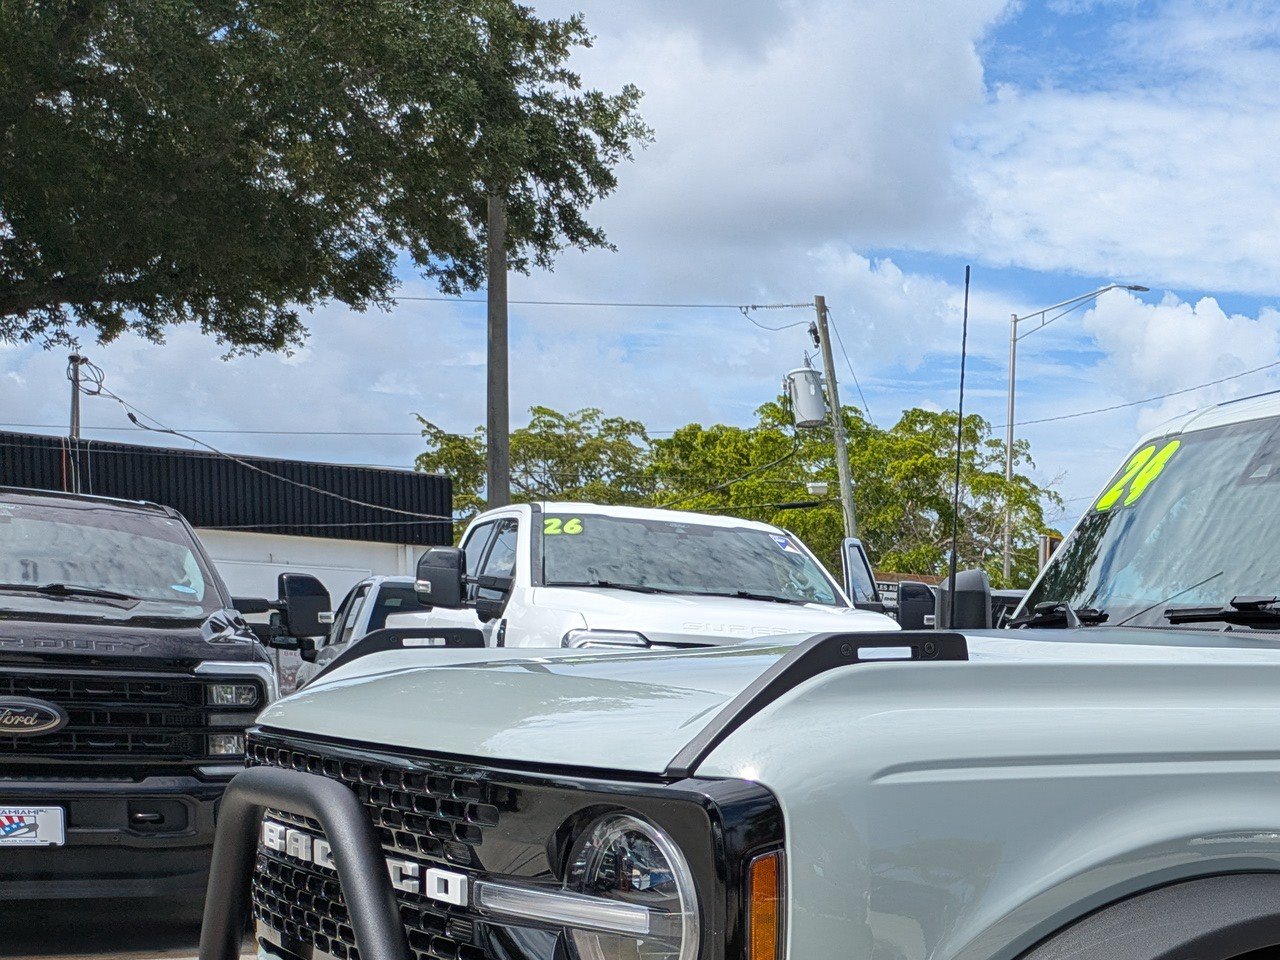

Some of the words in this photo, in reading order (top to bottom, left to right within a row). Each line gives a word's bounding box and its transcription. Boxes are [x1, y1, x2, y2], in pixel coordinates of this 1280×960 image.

[1095, 440, 1181, 512] 24
[543, 518, 583, 536] 26
[682, 621, 791, 637] SUPER
[261, 820, 468, 907] BROCO
